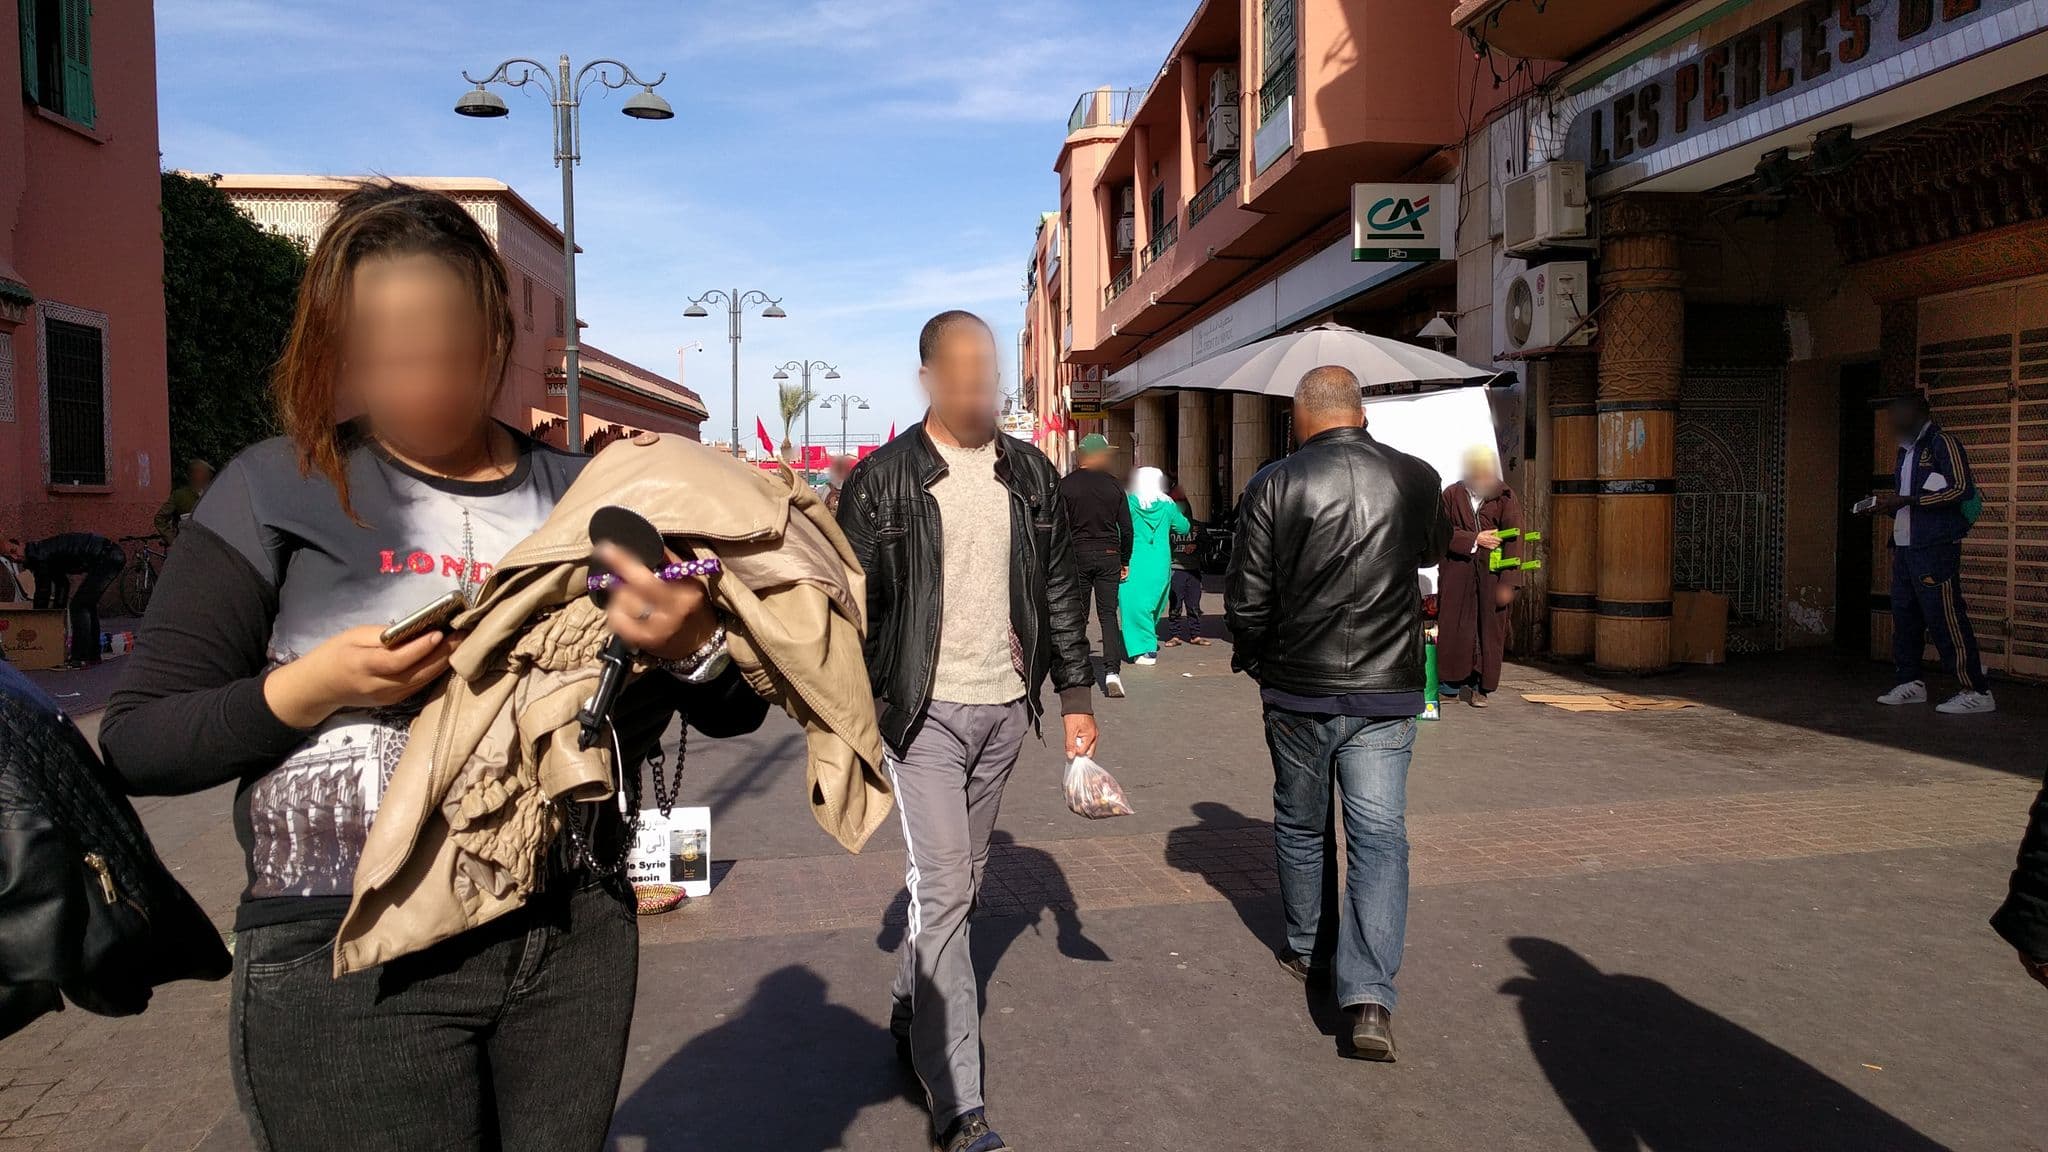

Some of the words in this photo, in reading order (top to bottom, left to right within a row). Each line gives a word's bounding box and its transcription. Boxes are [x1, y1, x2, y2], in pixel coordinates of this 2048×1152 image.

[1590, 83, 1660, 169] LES
[1674, 0, 1871, 134] PERLES
[1536, 298, 1545, 307] LG
[639, 860, 666, 871] Syrie
